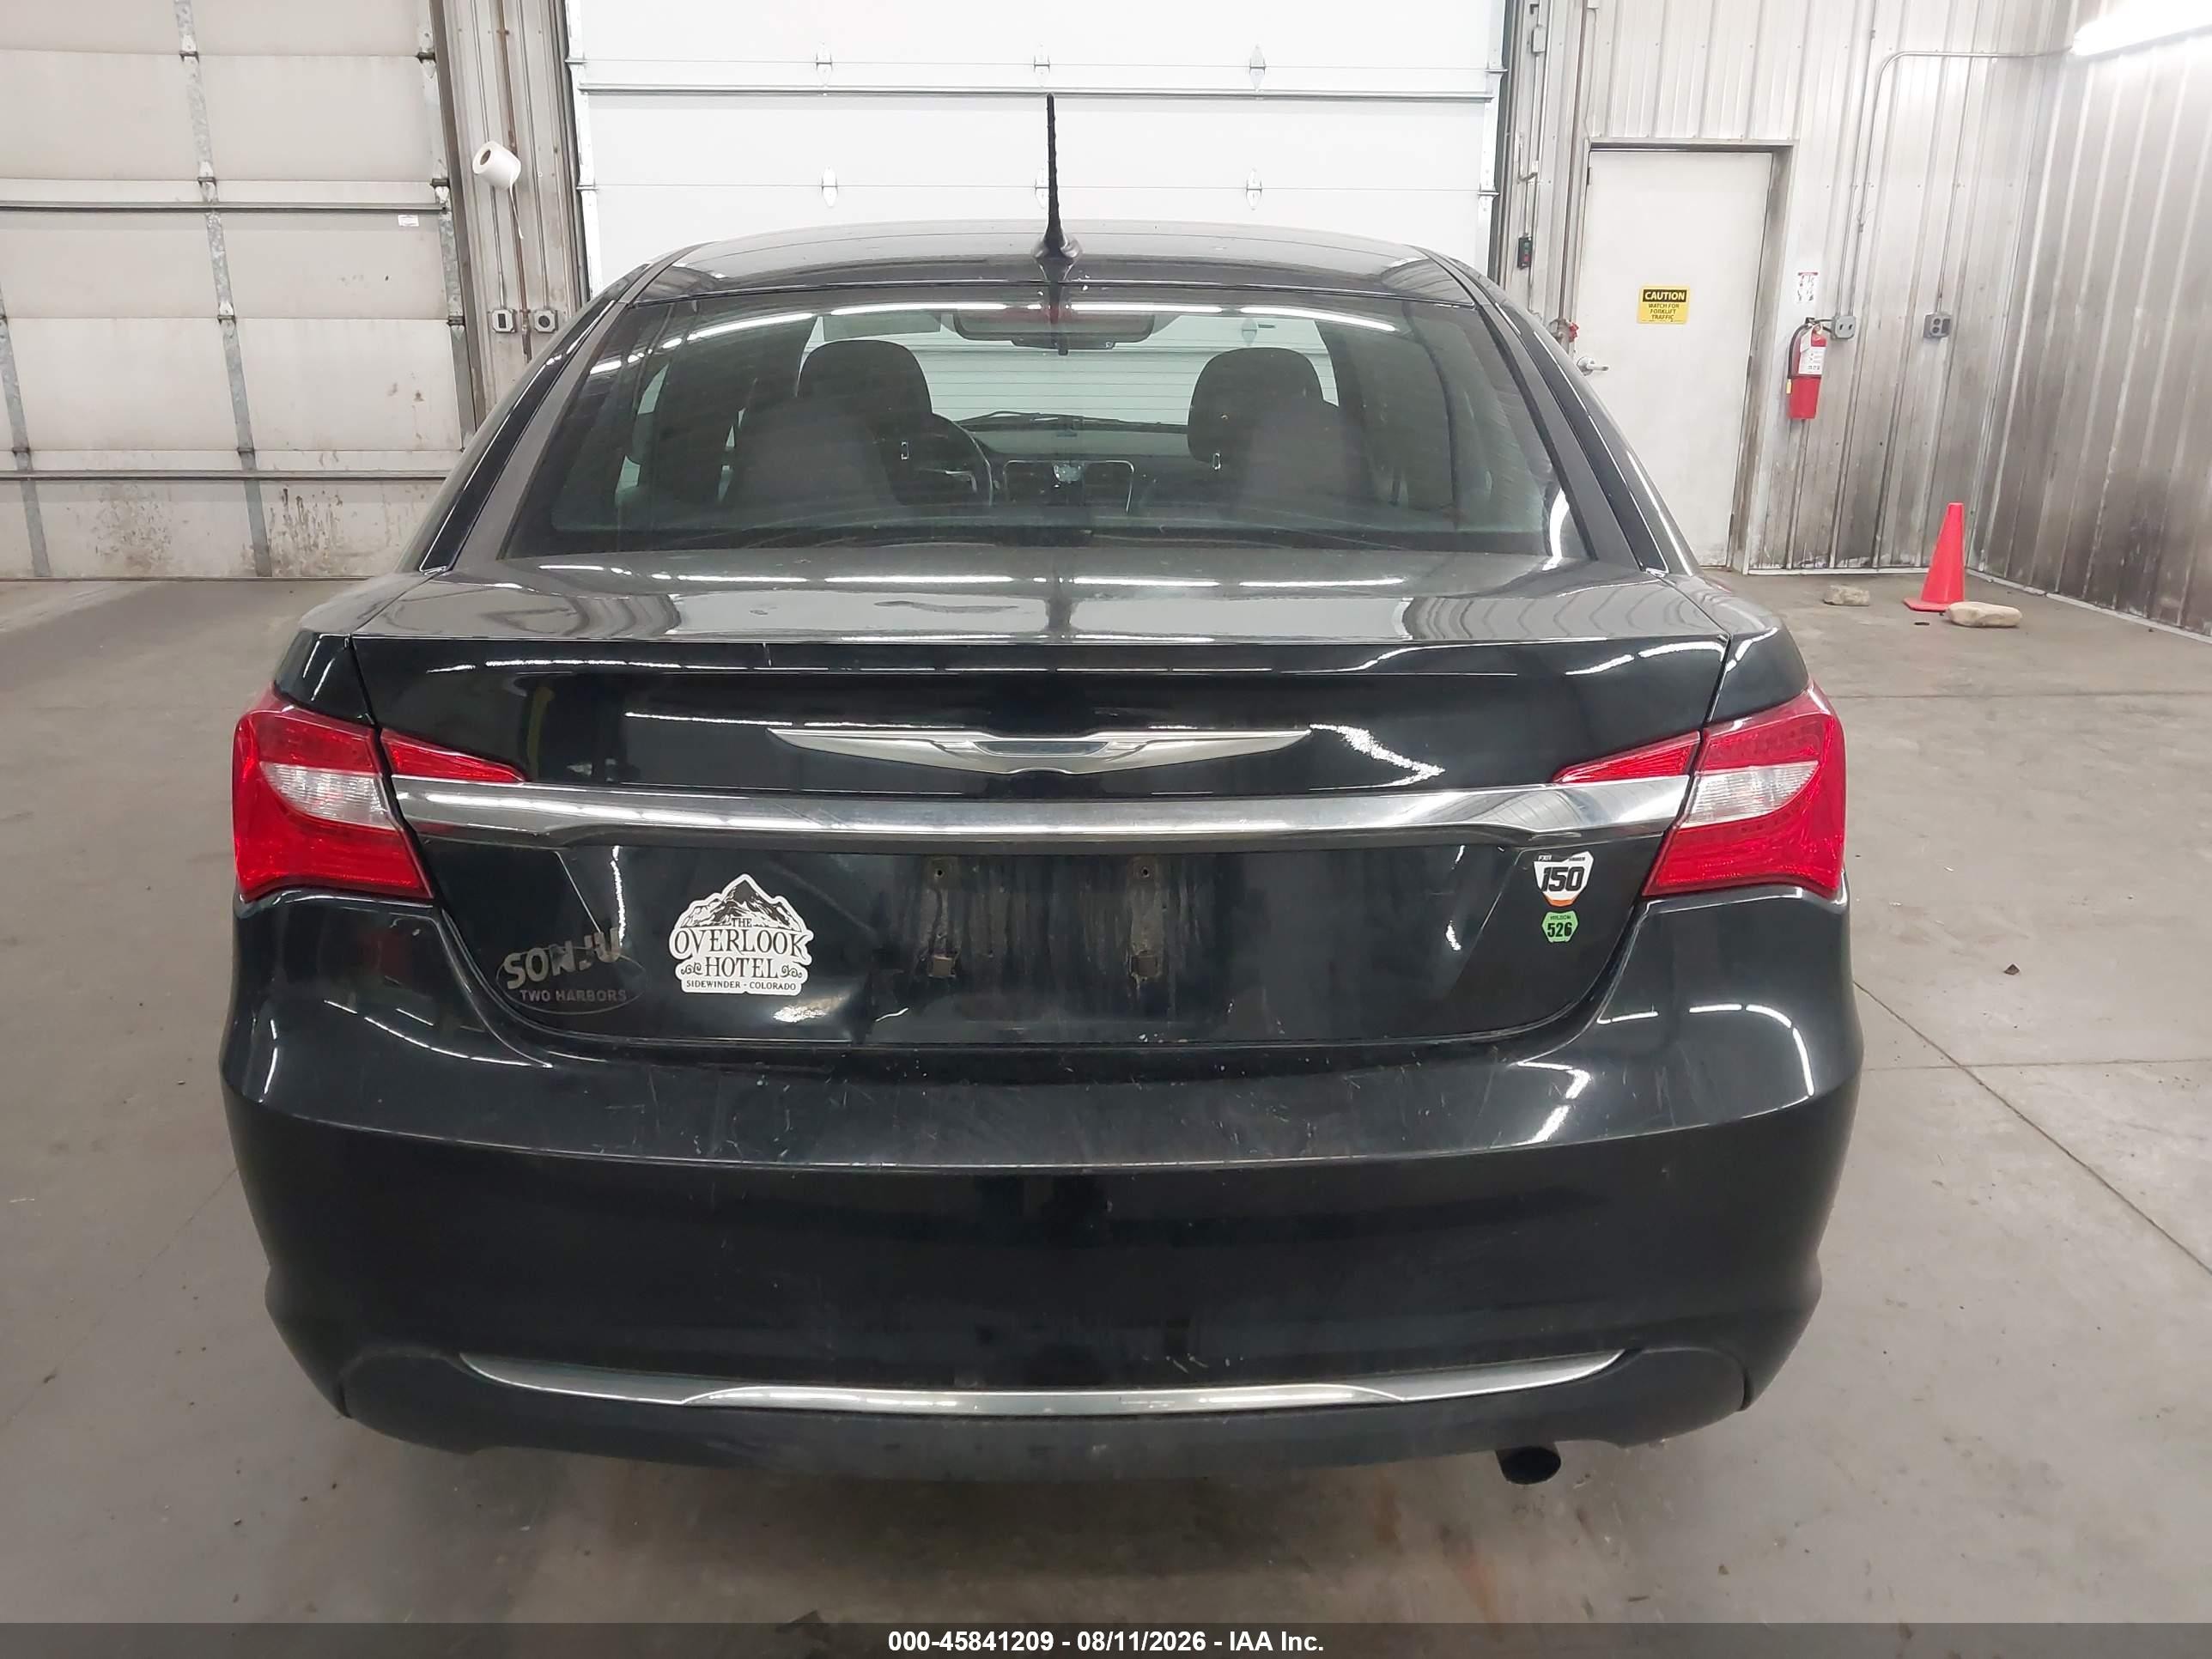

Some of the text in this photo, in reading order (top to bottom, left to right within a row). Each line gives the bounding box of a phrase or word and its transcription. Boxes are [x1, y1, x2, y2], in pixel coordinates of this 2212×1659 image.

[1644, 291, 1685, 301] CAUTION
[1540, 866, 1585, 892] 150
[732, 918, 752, 927] THE
[1547, 922, 1573, 938] 526
[674, 928, 808, 960] OVERLOOK
[705, 957, 779, 979] HOTEL
[686, 980, 741, 988] SIDEWINDER
[750, 981, 797, 991] COLORADO
[520, 989, 628, 1002] TWO HARBORS
